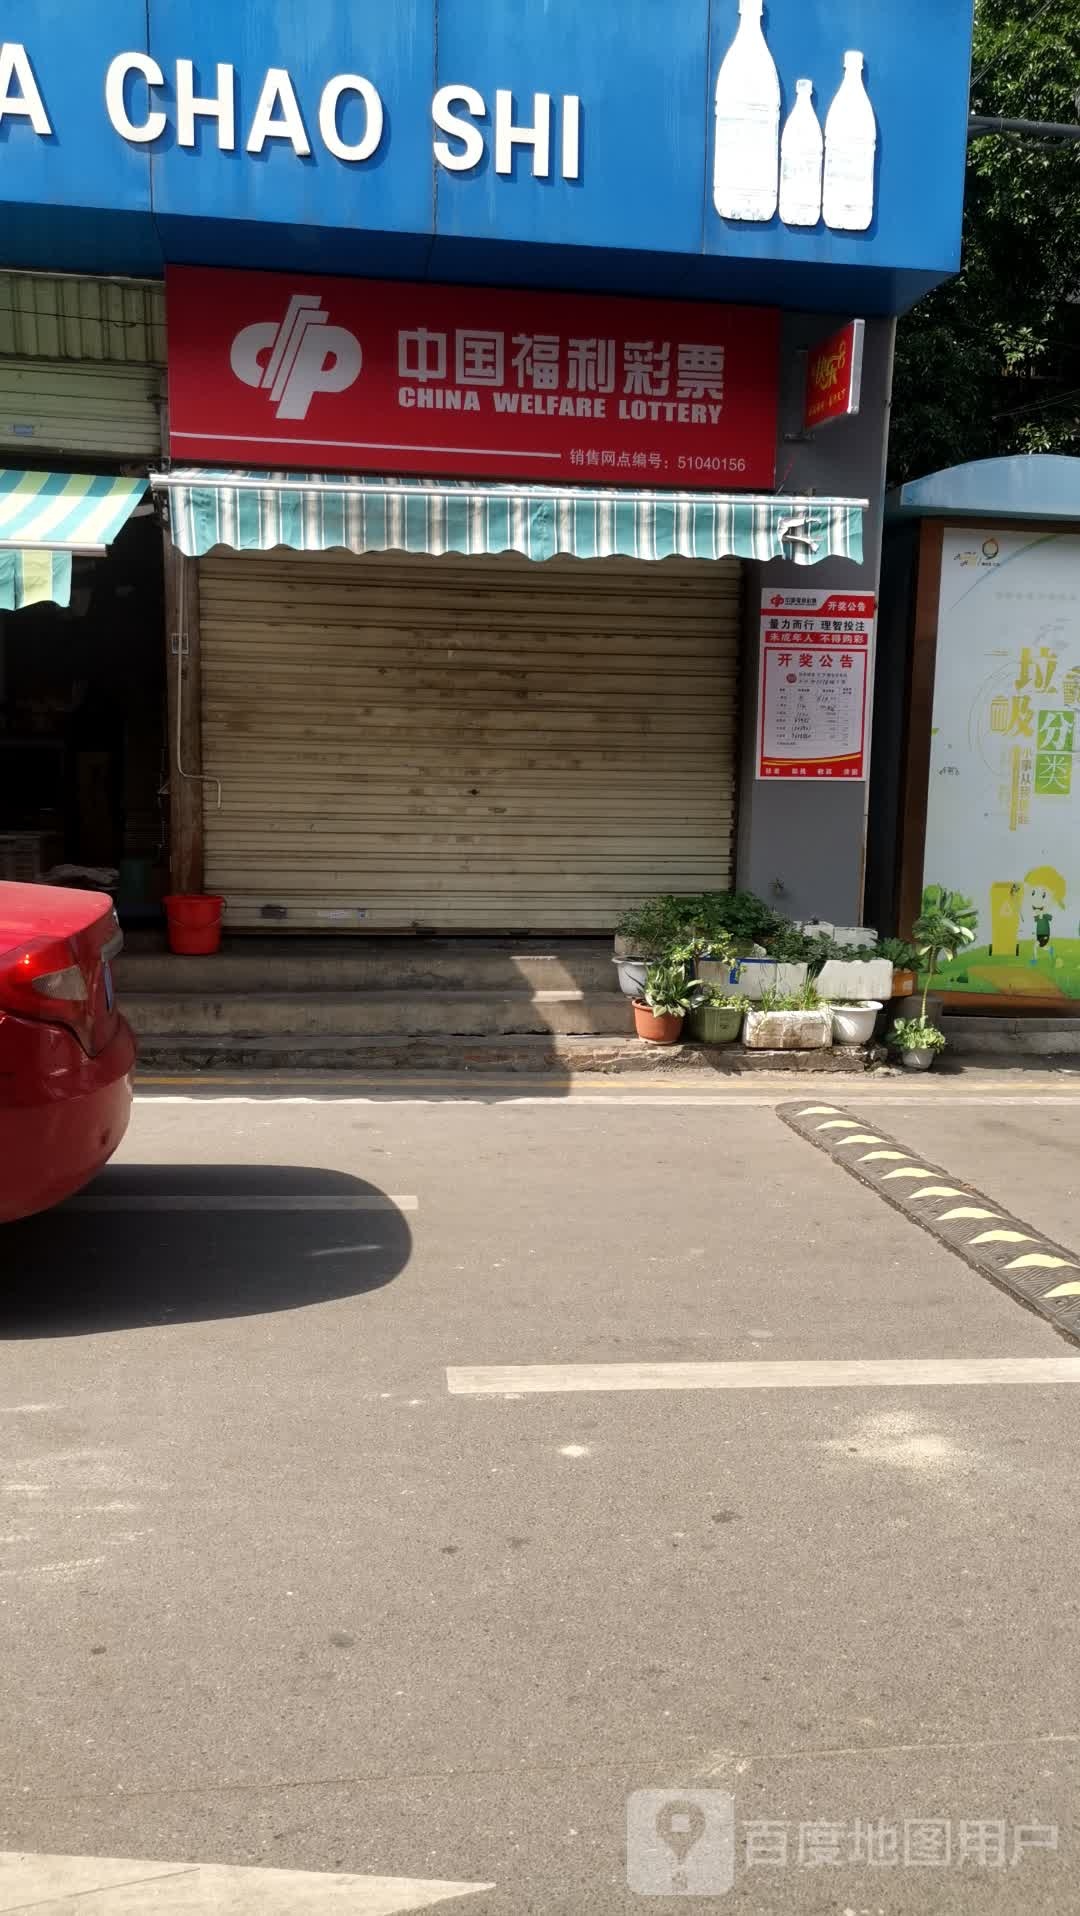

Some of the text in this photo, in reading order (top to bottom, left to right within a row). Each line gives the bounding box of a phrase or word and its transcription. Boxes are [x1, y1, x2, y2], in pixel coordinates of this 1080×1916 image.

[104, 51, 384, 162] CHAO
[431, 84, 581, 180] SHI
[398, 328, 725, 400] 中国福利彩票
[398, 387, 723, 425] CHINA WELFARE LOTTERY
[677, 456, 746, 471] 51040156
[828, 601, 866, 612] 开奖公告
[769, 618, 865, 631] 量力而行 理智投注
[770, 633, 864, 644] 未成年人 不得购彩
[777, 653, 854, 668] 开奖公告
[1038, 710, 1074, 794] 分类
